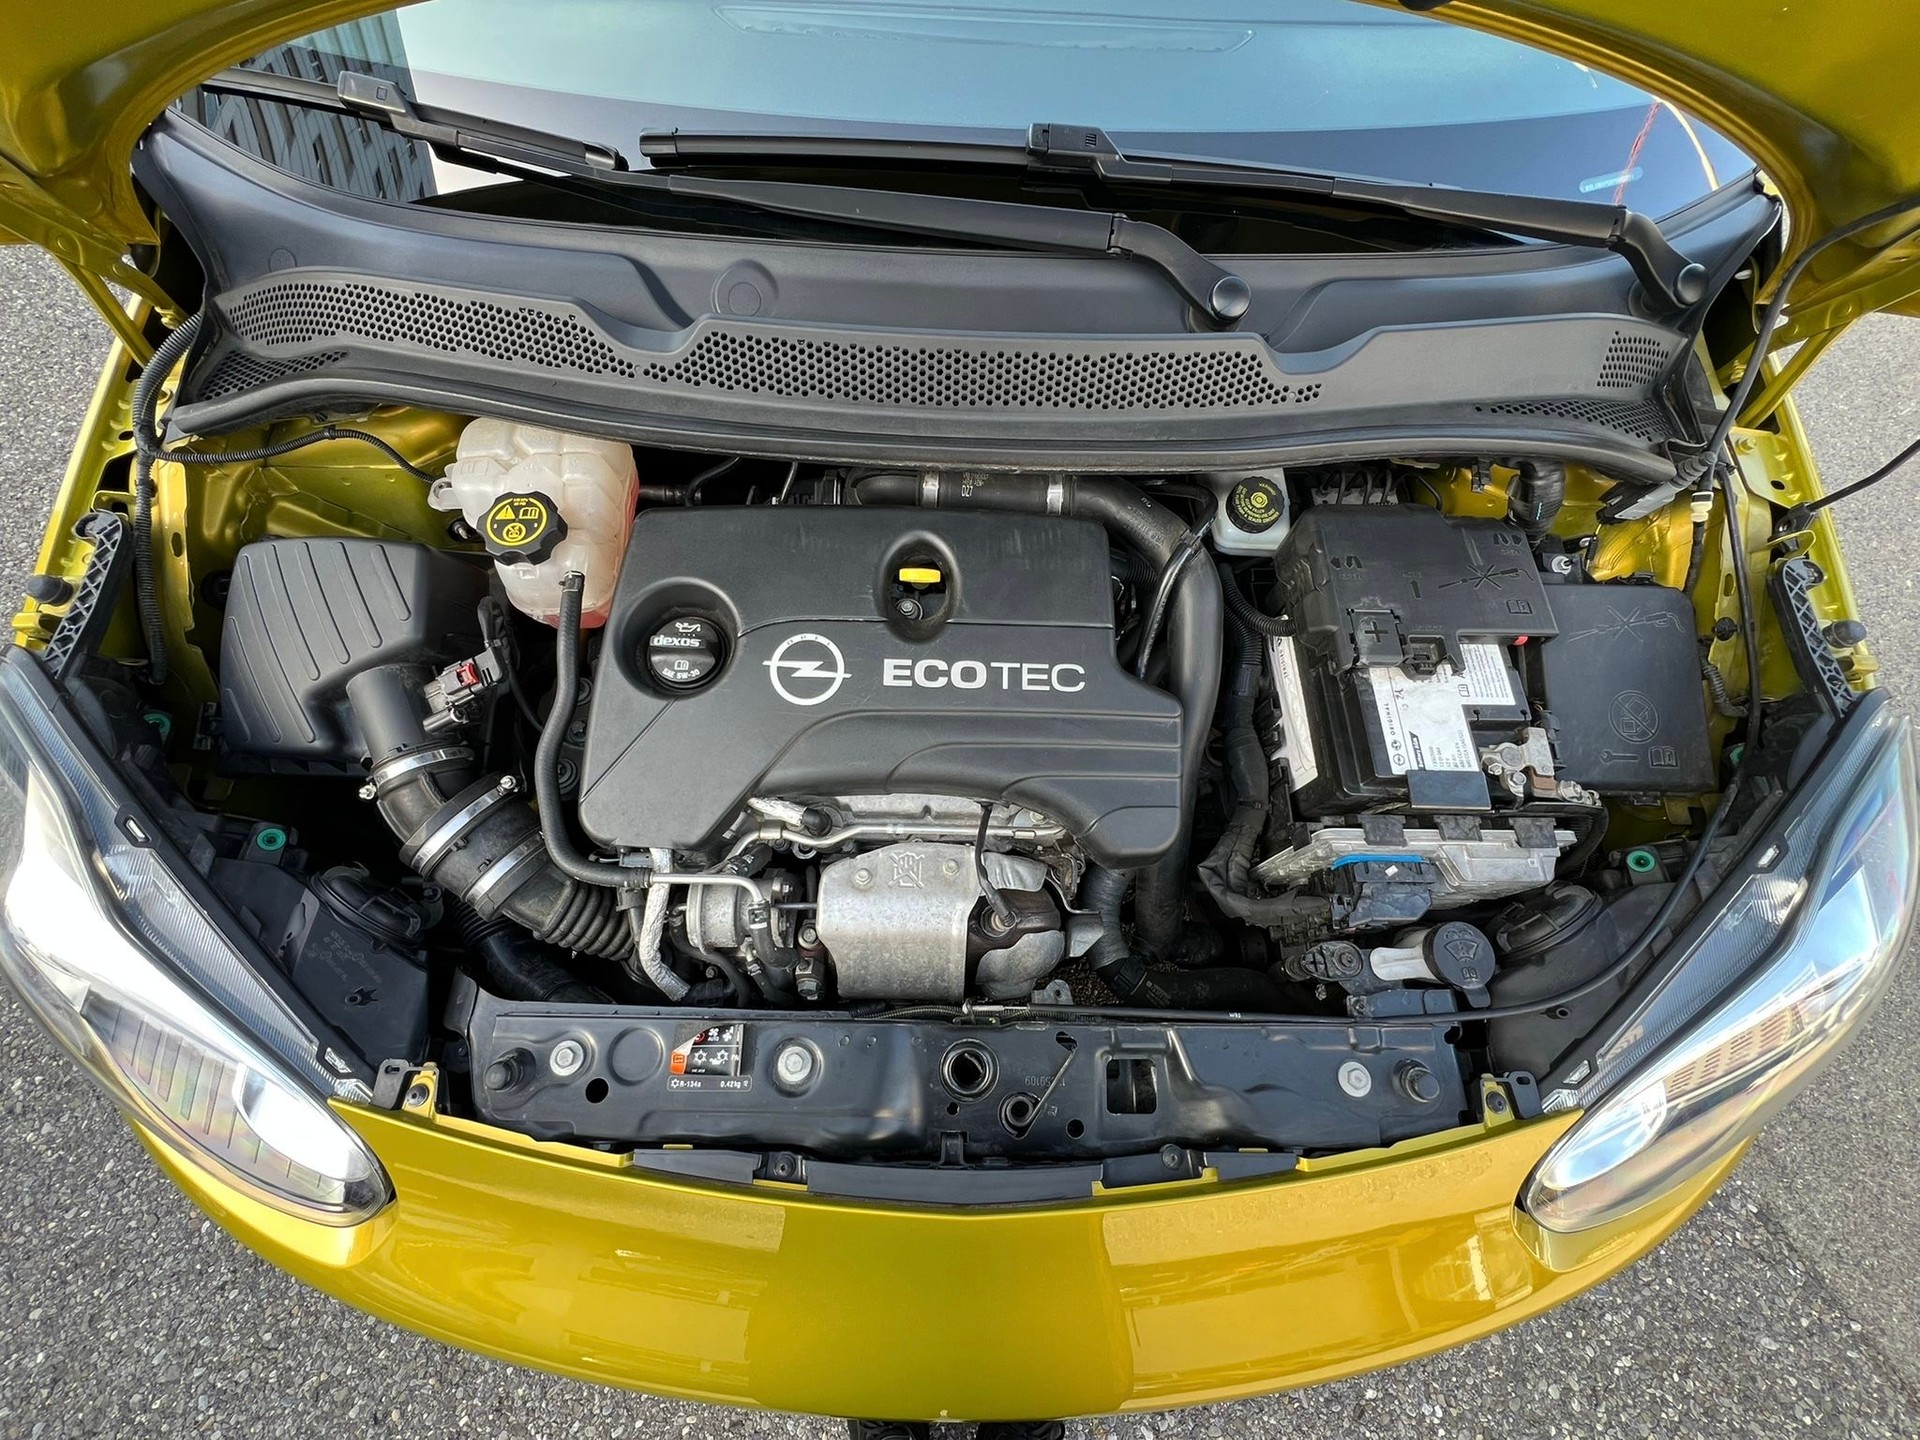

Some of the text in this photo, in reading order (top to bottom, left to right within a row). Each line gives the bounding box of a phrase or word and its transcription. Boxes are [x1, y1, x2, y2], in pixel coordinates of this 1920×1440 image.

[653, 634, 702, 648] dexos
[676, 668, 701, 679] 5W-30
[883, 658, 1086, 693] ECOTEC
